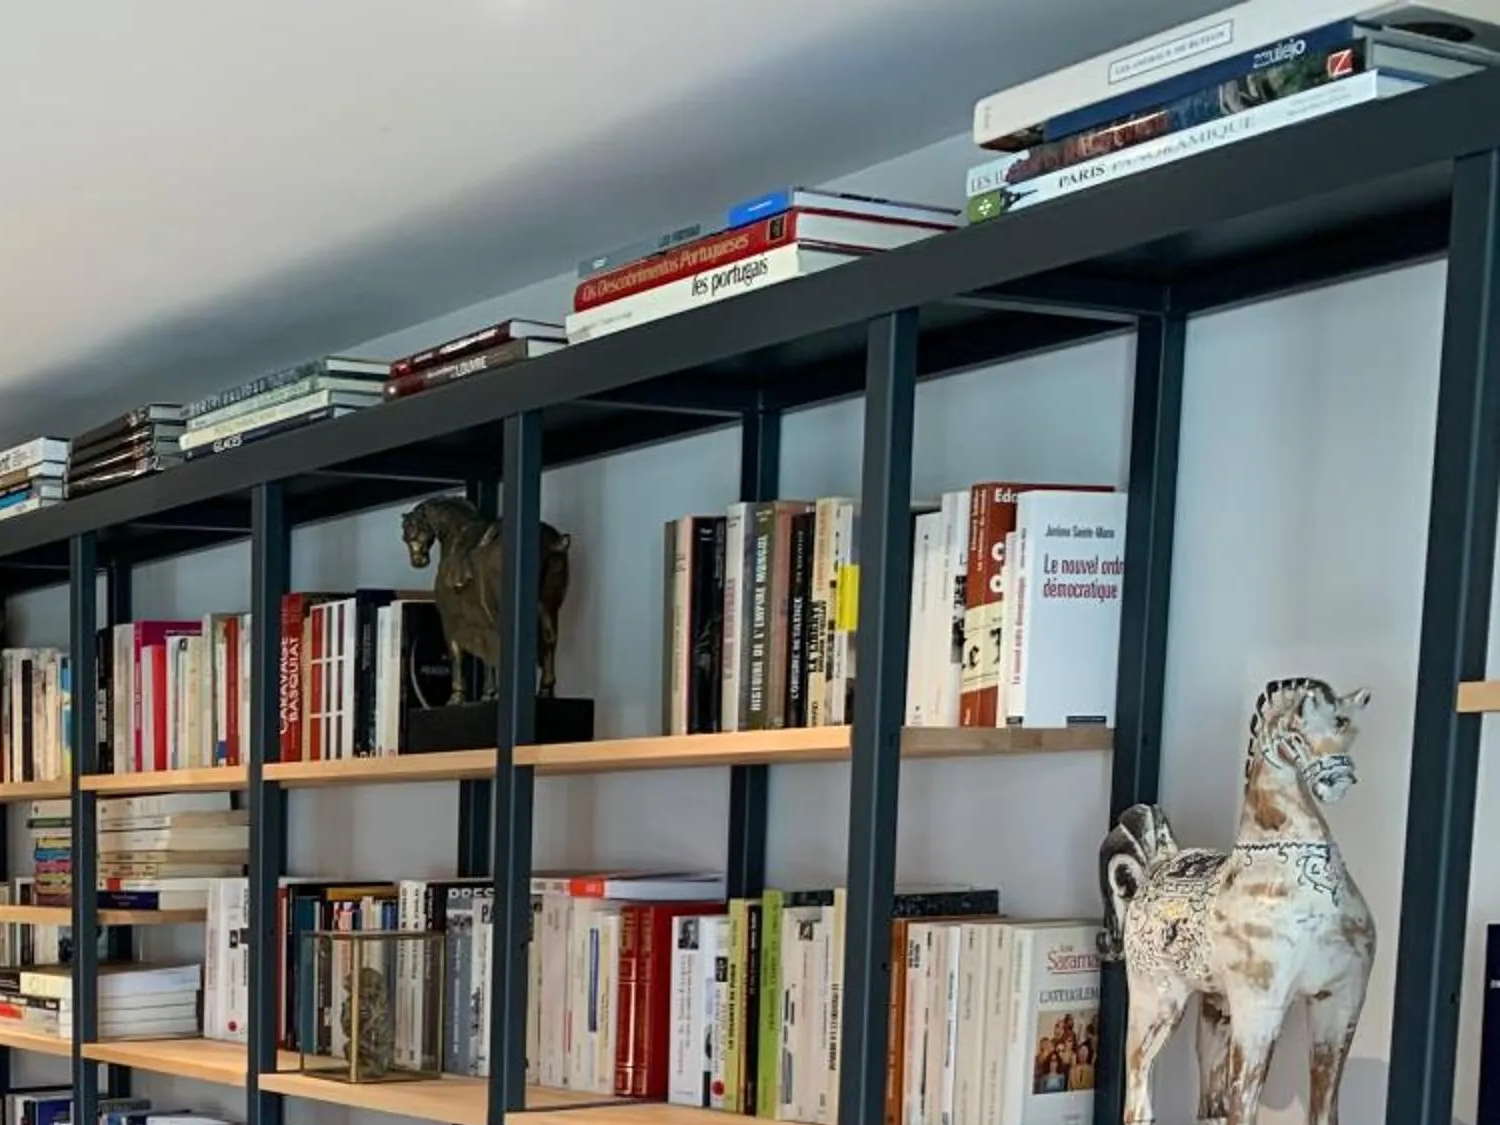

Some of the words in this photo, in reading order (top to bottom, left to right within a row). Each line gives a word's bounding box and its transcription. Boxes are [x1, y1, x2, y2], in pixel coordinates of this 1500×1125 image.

[1058, 161, 1106, 189] PARIS
[691, 272, 709, 298] les
[710, 256, 769, 295] portugais
[1043, 554, 1058, 574] Le
[1060, 553, 1098, 575] nouvel
[1043, 577, 1118, 603] démocratique
[289, 635, 300, 723] BASQUIAT
